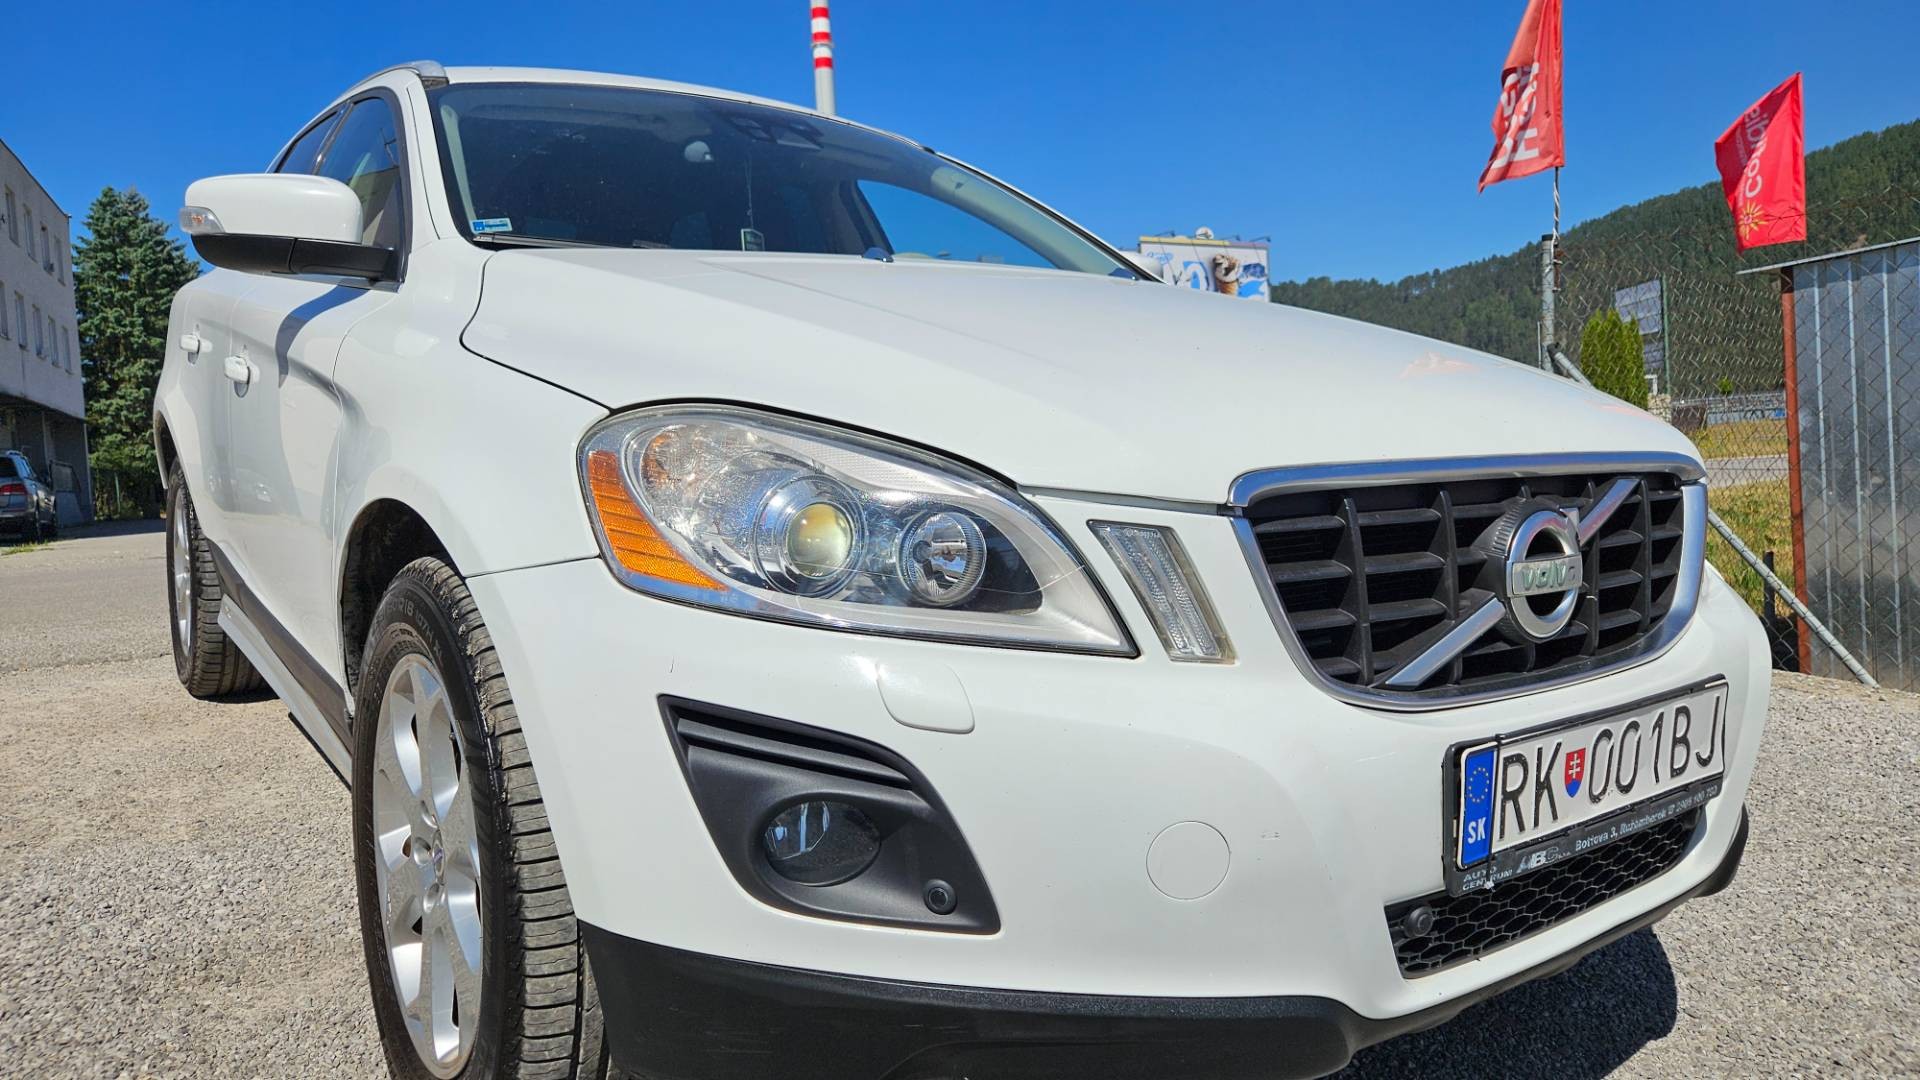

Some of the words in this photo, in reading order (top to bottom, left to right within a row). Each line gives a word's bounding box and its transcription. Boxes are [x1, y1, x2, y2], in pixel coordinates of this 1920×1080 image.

[1499, 741, 1562, 839] RK
[1467, 817, 1486, 844] SK
[1462, 869, 1513, 891] CENRUM
